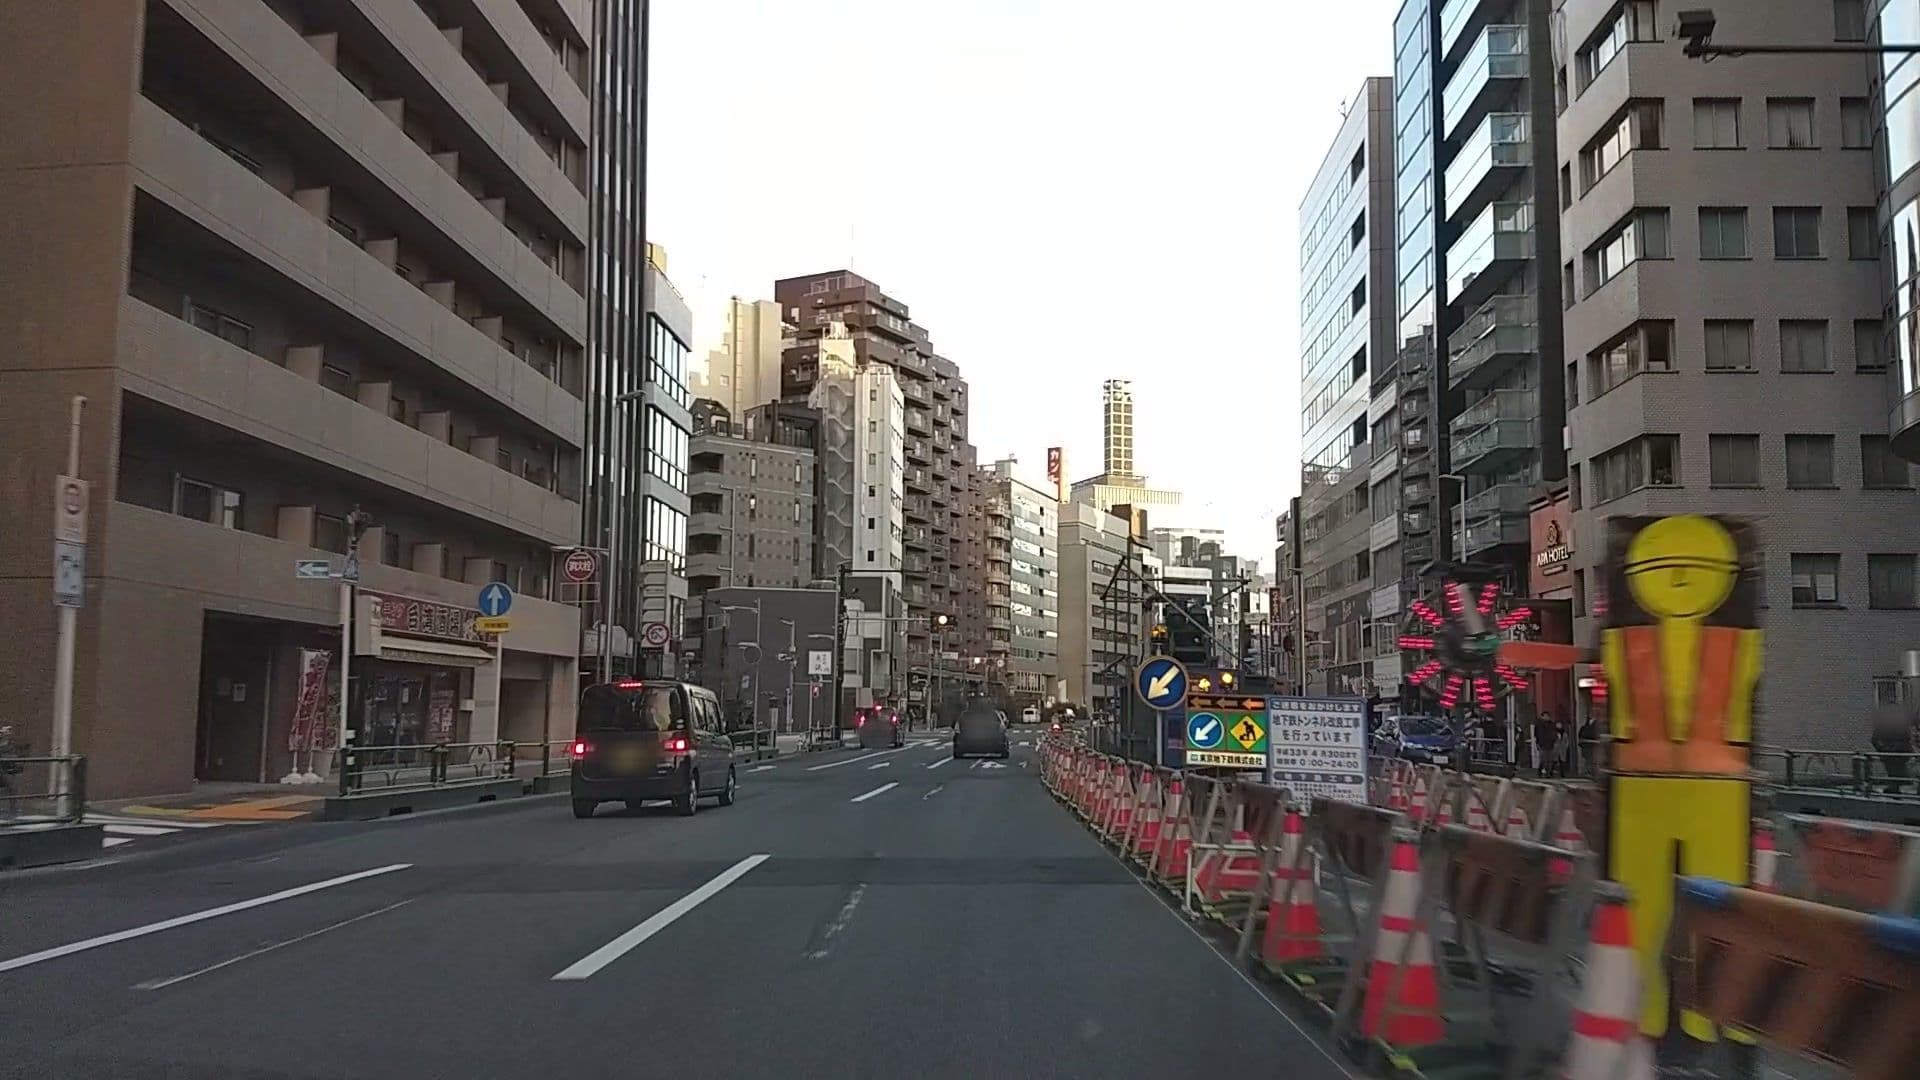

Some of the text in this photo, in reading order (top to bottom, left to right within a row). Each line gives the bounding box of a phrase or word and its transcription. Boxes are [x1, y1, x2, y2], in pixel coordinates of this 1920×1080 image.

[1537, 546, 1568, 567] APA HOTEL
[569, 561, 591, 571] 消火栓
[1273, 702, 1360, 711] ご迷惑をおかけします
[1272, 714, 1360, 728] 地下鉄トンネル改良工事
[1282, 729, 1352, 742] を行っています
[1200, 754, 1262, 765] 東京地下鉄株式会社
